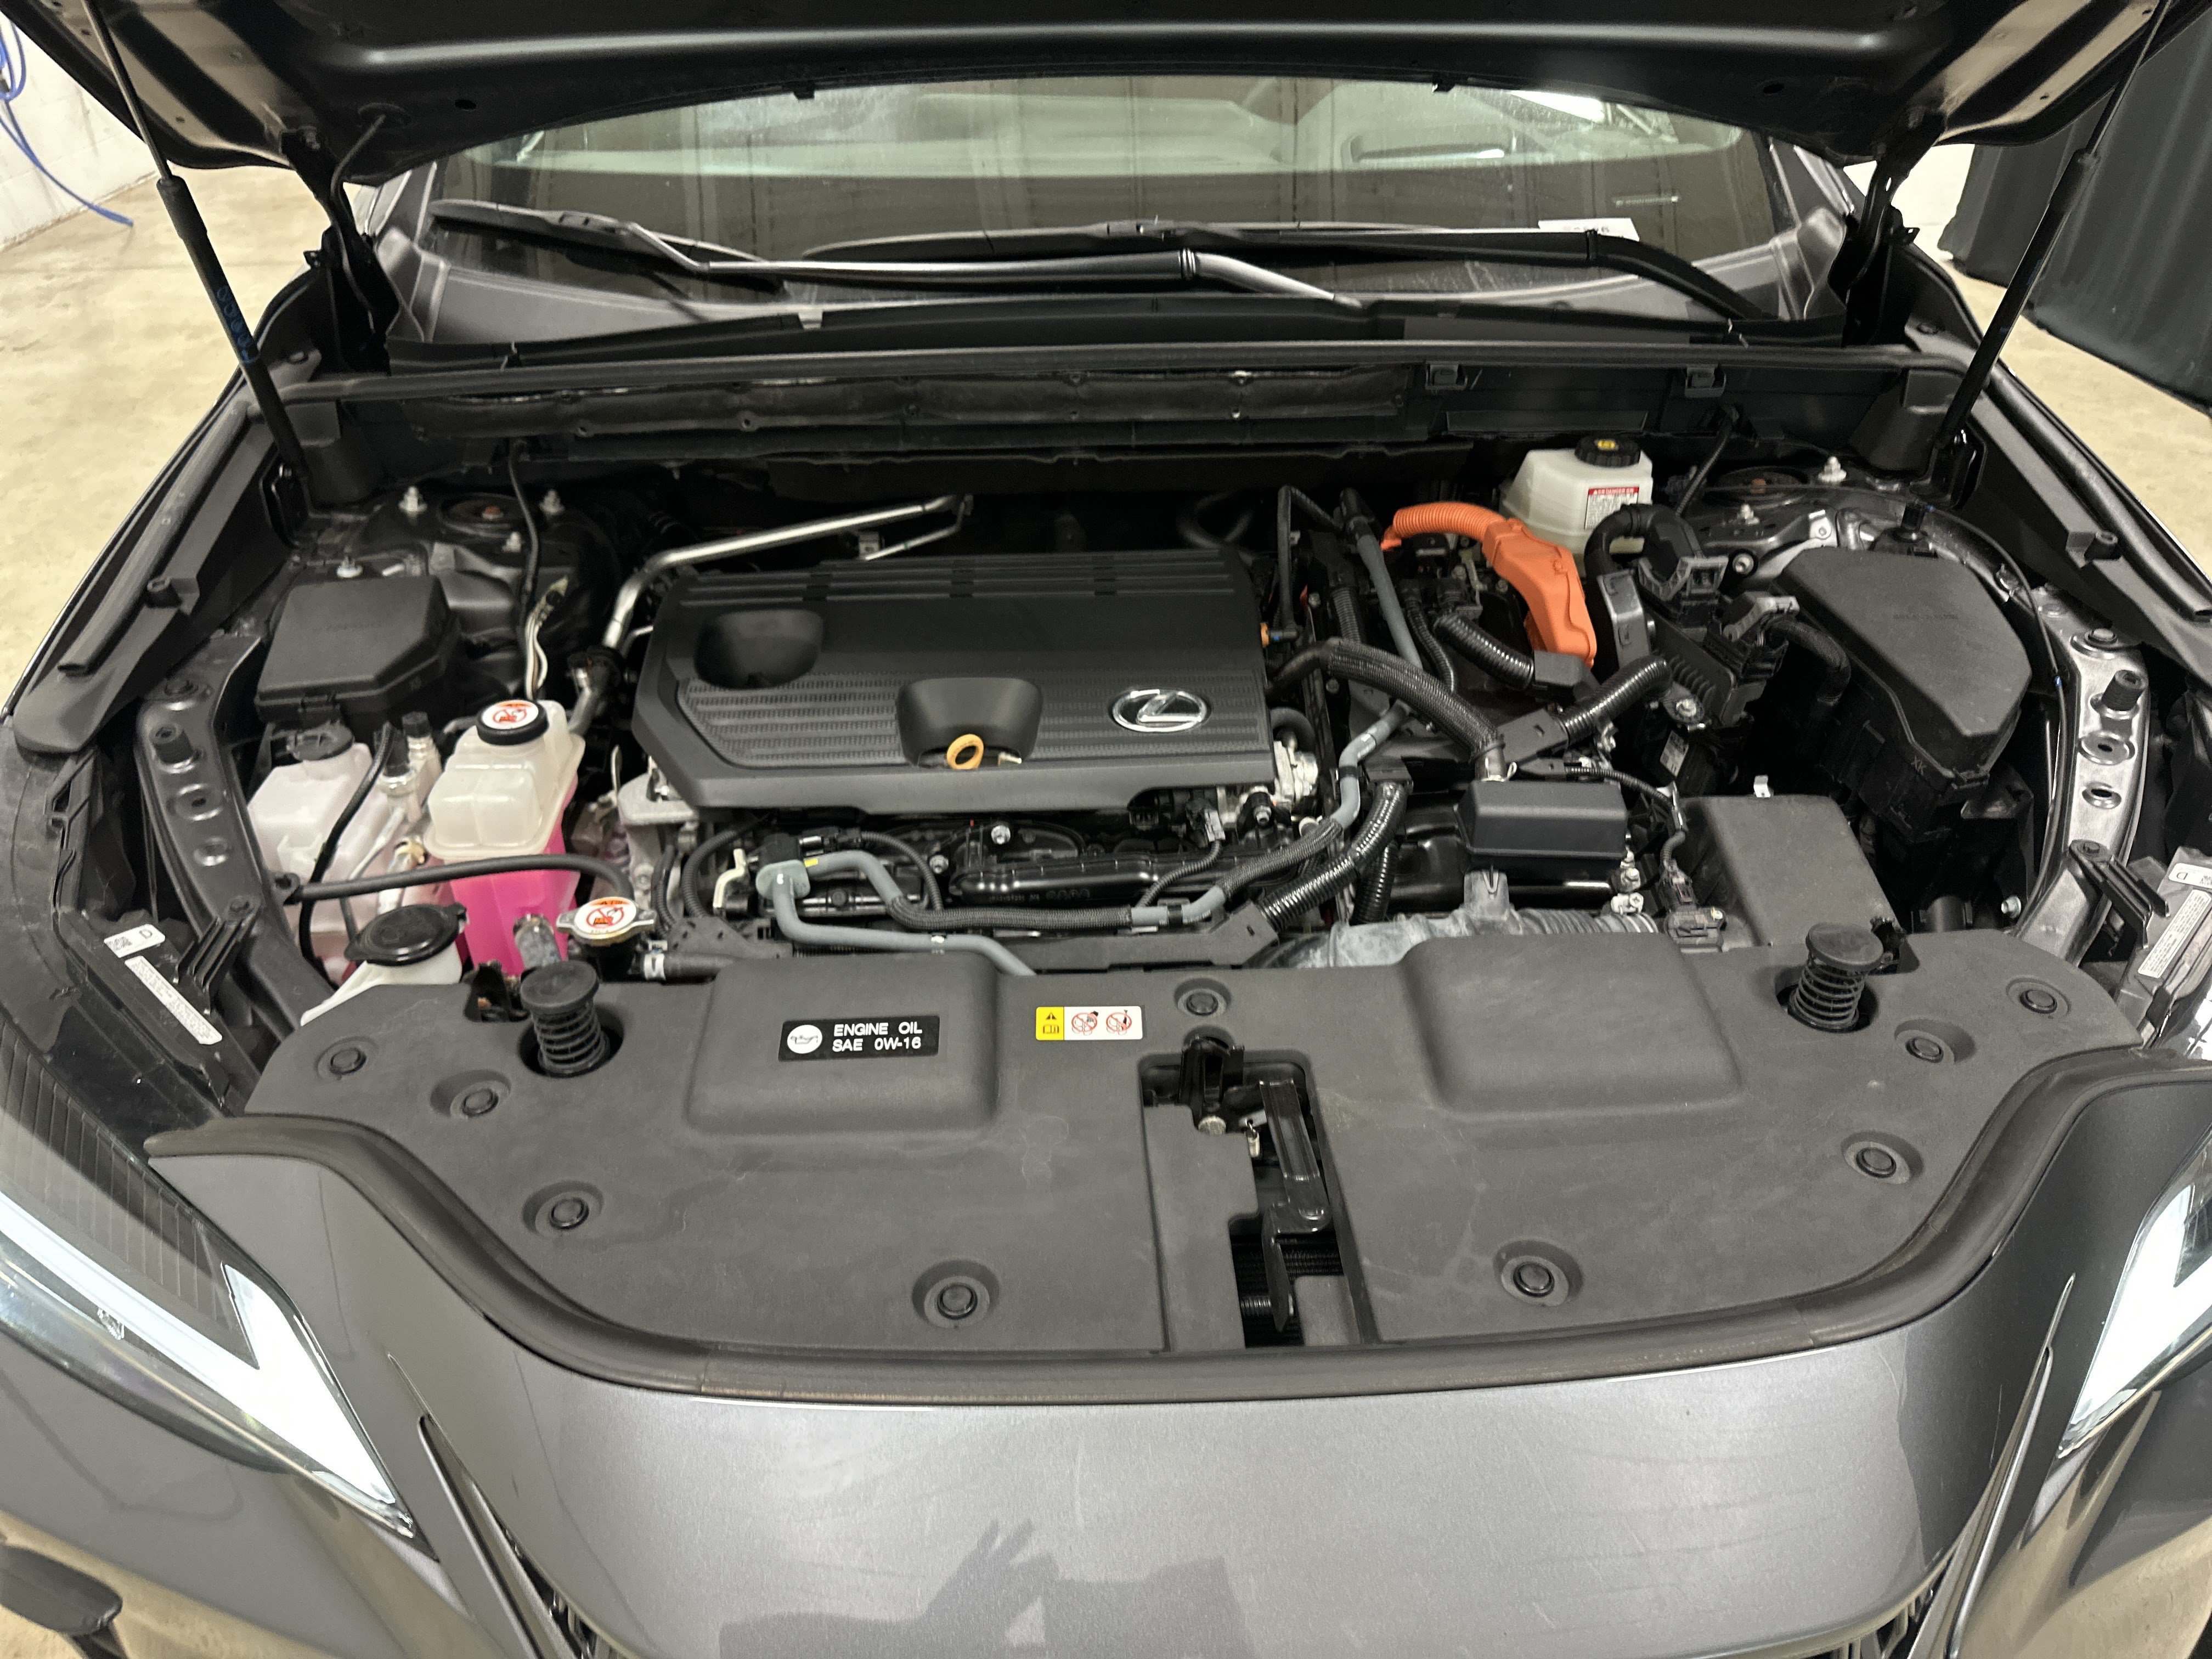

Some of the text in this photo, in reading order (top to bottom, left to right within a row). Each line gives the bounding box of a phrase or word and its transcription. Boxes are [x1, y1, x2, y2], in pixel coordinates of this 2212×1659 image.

[833, 1022, 922, 1036] ENGINE OIL
[832, 1037, 921, 1052] SAE 0W-16
